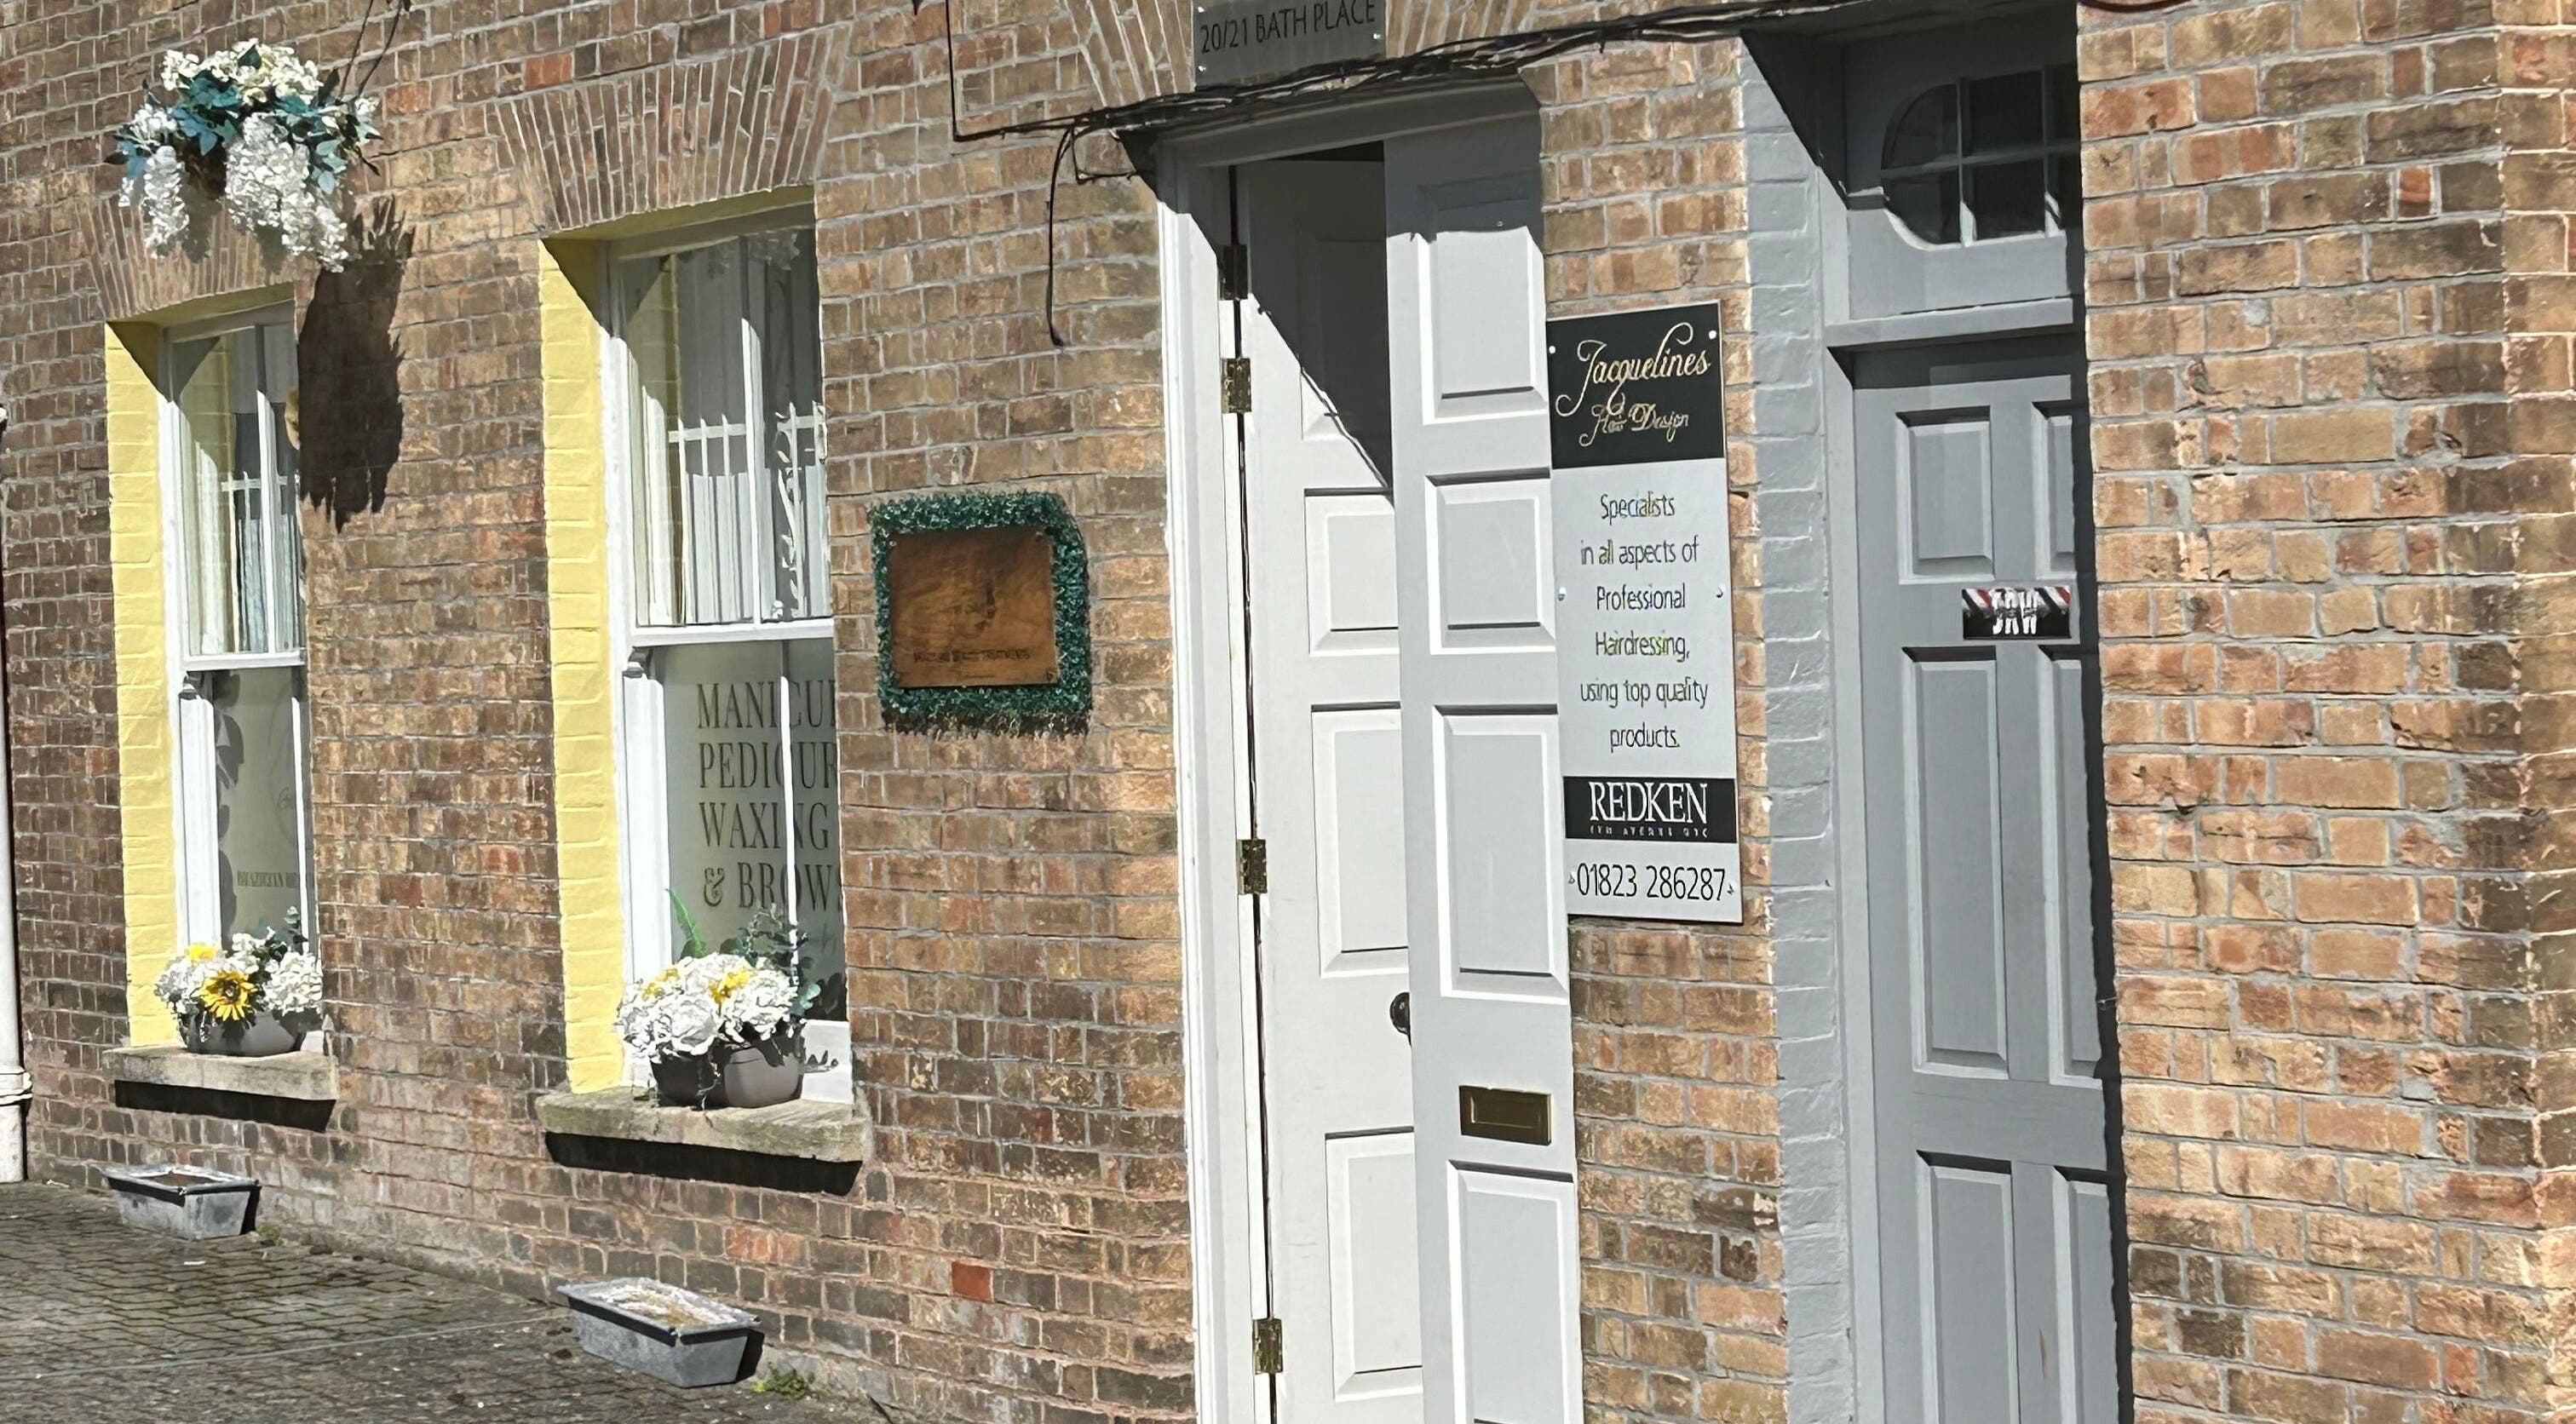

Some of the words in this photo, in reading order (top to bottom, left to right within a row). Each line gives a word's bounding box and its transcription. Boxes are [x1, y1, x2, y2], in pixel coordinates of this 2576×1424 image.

[1199, 18, 1248, 54] 20/21
[1256, 6, 1307, 43] BATH
[1314, 0, 1376, 32] PLACE
[1555, 322, 1711, 416] Jacquelines
[1628, 404, 1689, 442] Design
[1601, 491, 1676, 525] Specialists
[1580, 539, 1593, 566] in
[1598, 538, 1614, 565] all
[1619, 540, 1676, 571] aspects
[1682, 535, 1699, 562] of
[1596, 582, 1686, 611] Professional
[1596, 629, 1689, 663] Hairdressing,
[1580, 678, 1619, 709] using
[1625, 680, 1650, 708] top
[1656, 676, 1708, 709] quality
[1610, 722, 1680, 754] products.
[1588, 781, 1707, 824] REDKEN
[699, 802, 828, 851] WAXING
[703, 868, 725, 908] &
[1578, 863, 1637, 898] 01823
[1646, 864, 1726, 901] 286287
